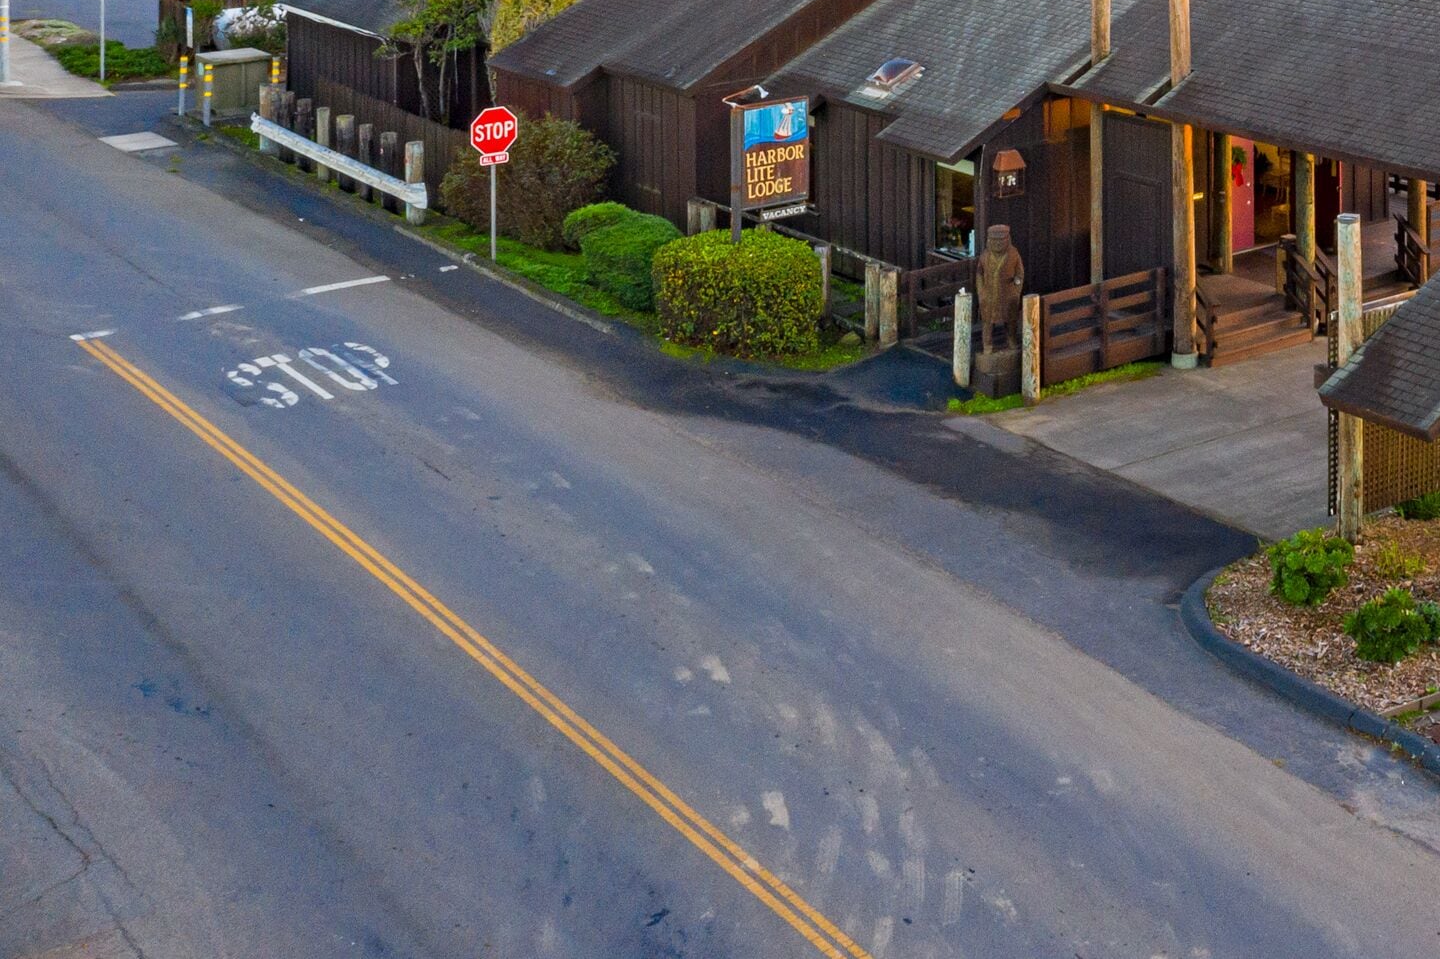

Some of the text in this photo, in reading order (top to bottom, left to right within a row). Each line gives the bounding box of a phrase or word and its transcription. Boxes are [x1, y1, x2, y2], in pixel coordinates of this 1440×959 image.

[475, 121, 514, 142] STOP
[746, 144, 804, 168] HARBOR
[747, 164, 775, 183] LITE
[748, 177, 792, 199] LODGE
[763, 205, 806, 220] VACANCY
[227, 342, 399, 408] STOP
